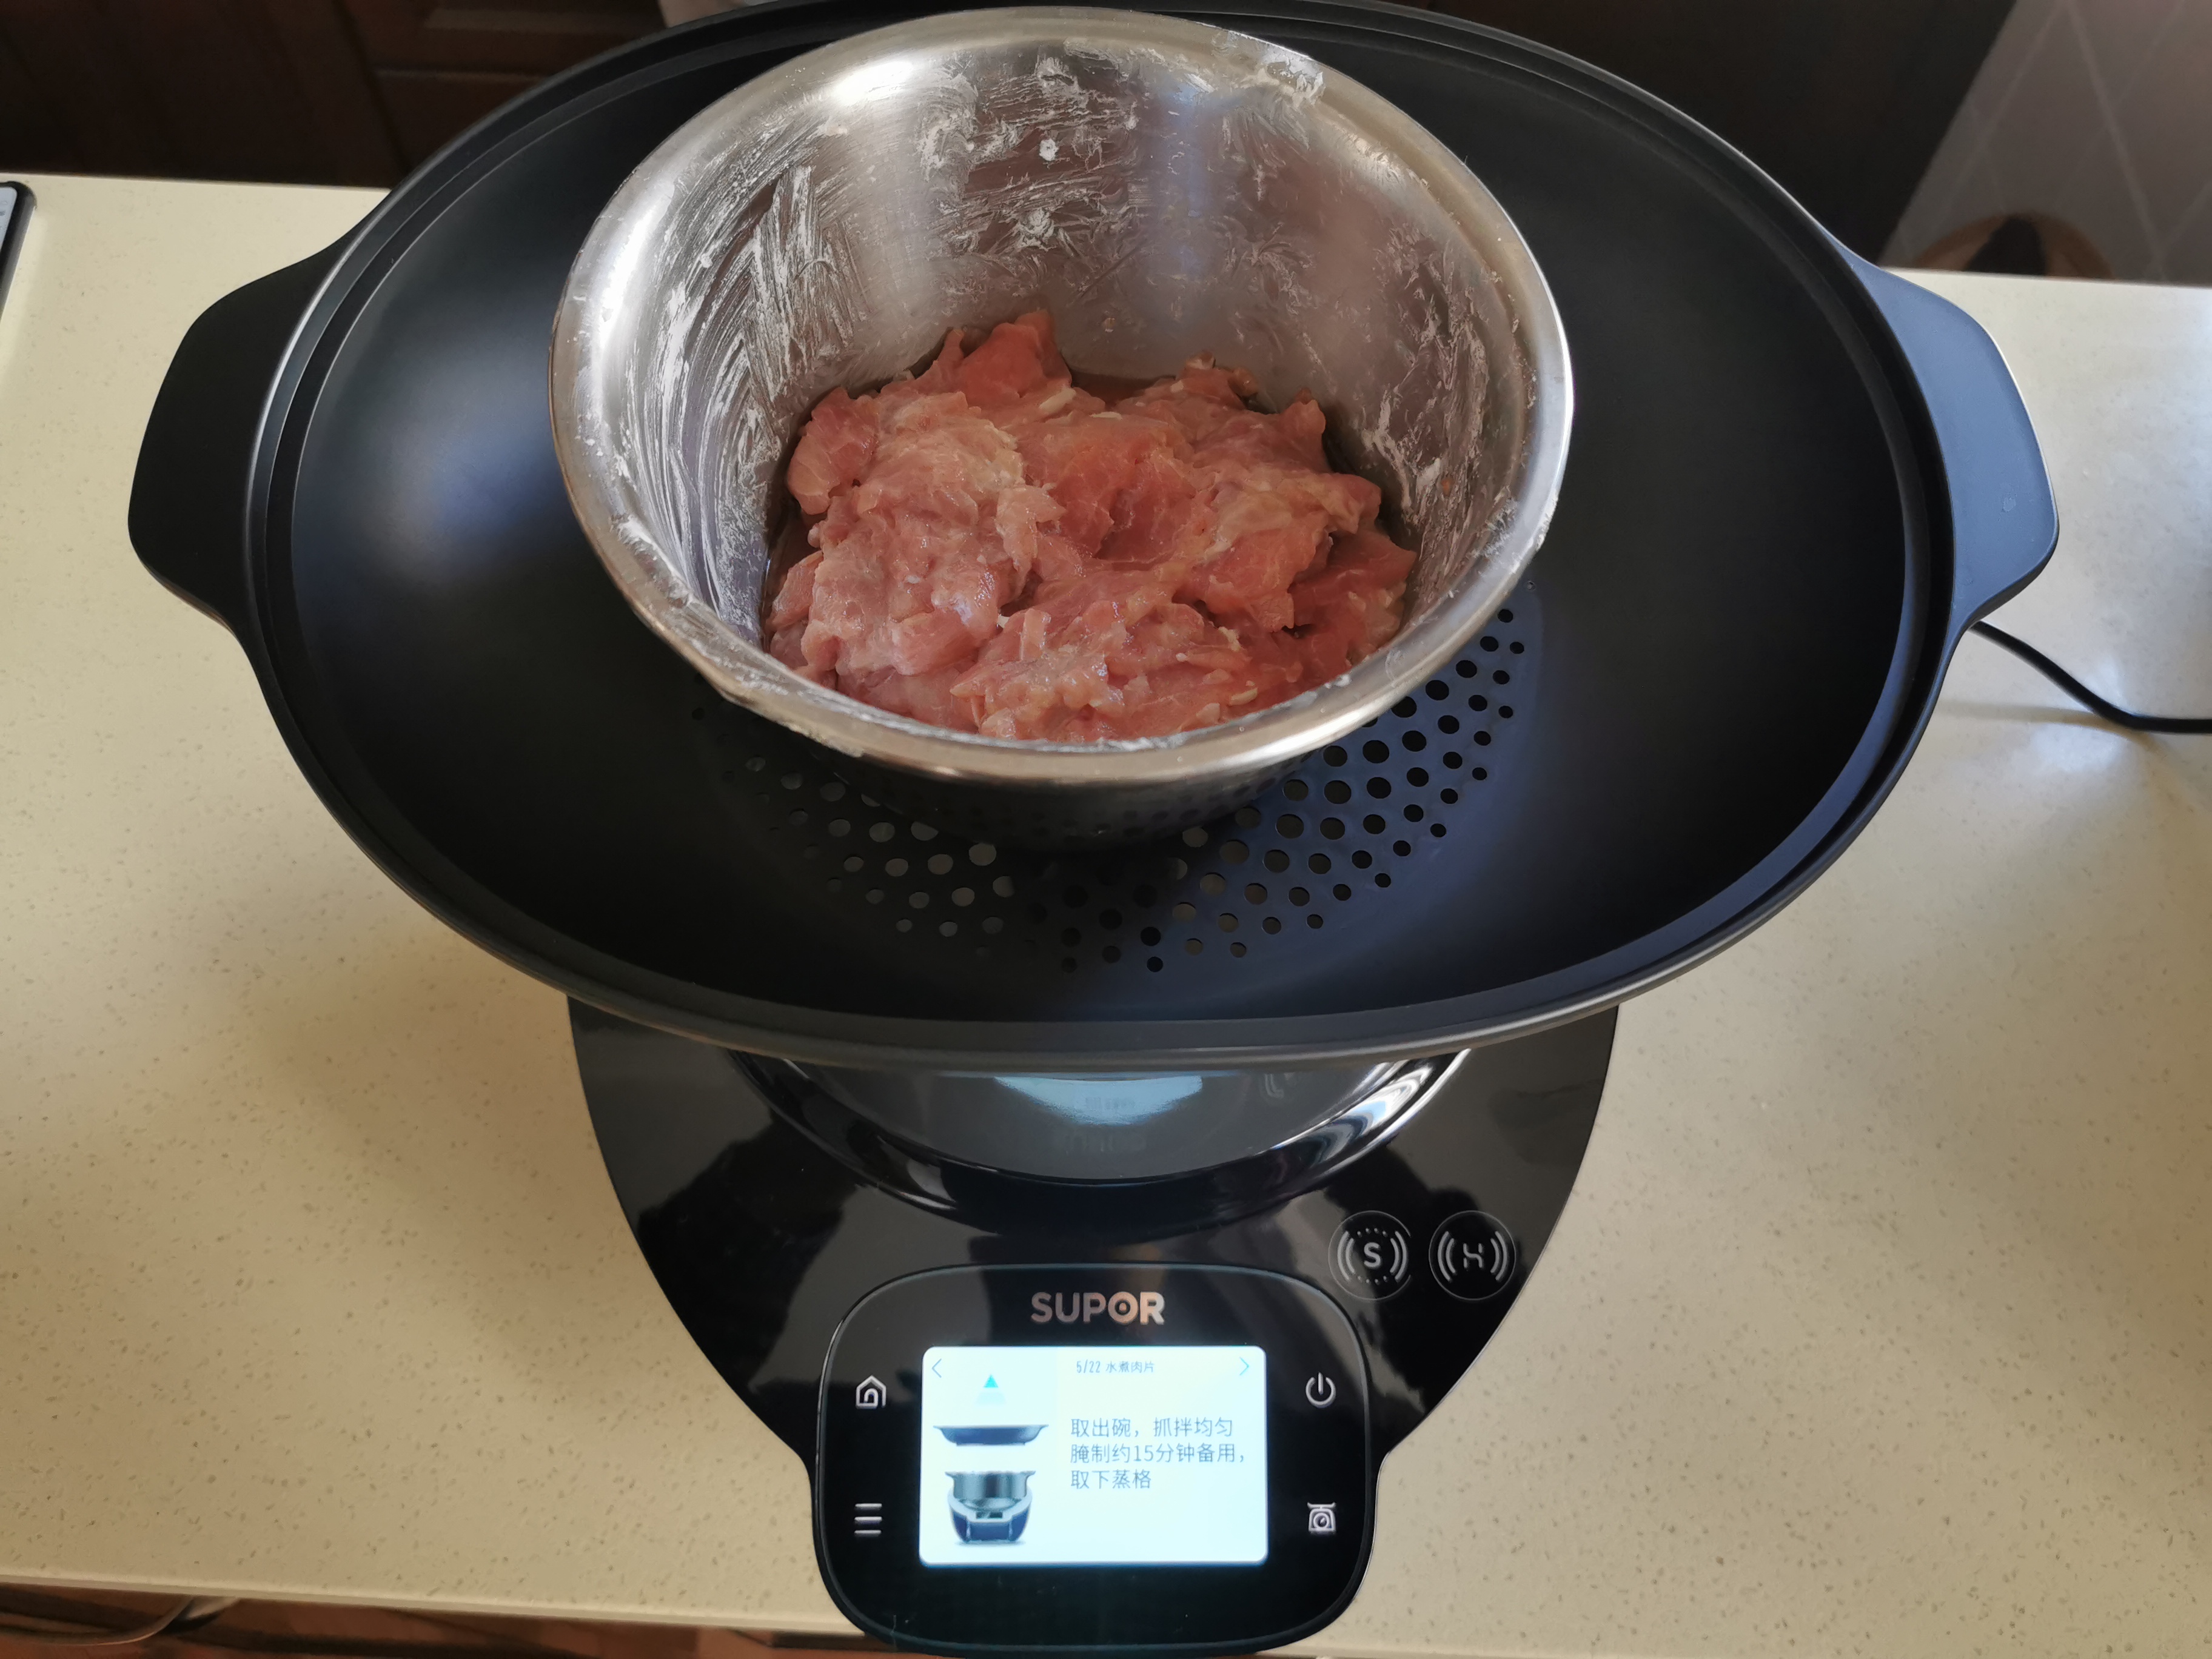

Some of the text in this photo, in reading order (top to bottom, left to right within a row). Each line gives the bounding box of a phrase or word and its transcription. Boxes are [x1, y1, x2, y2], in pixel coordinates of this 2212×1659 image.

[1364, 1242, 1381, 1269] S
[1031, 1291, 1165, 1325] SUPOR
[1076, 1359, 1155, 1373] 5/22 水煮肉片
[1070, 1469, 1151, 1489] 取下蒸格
